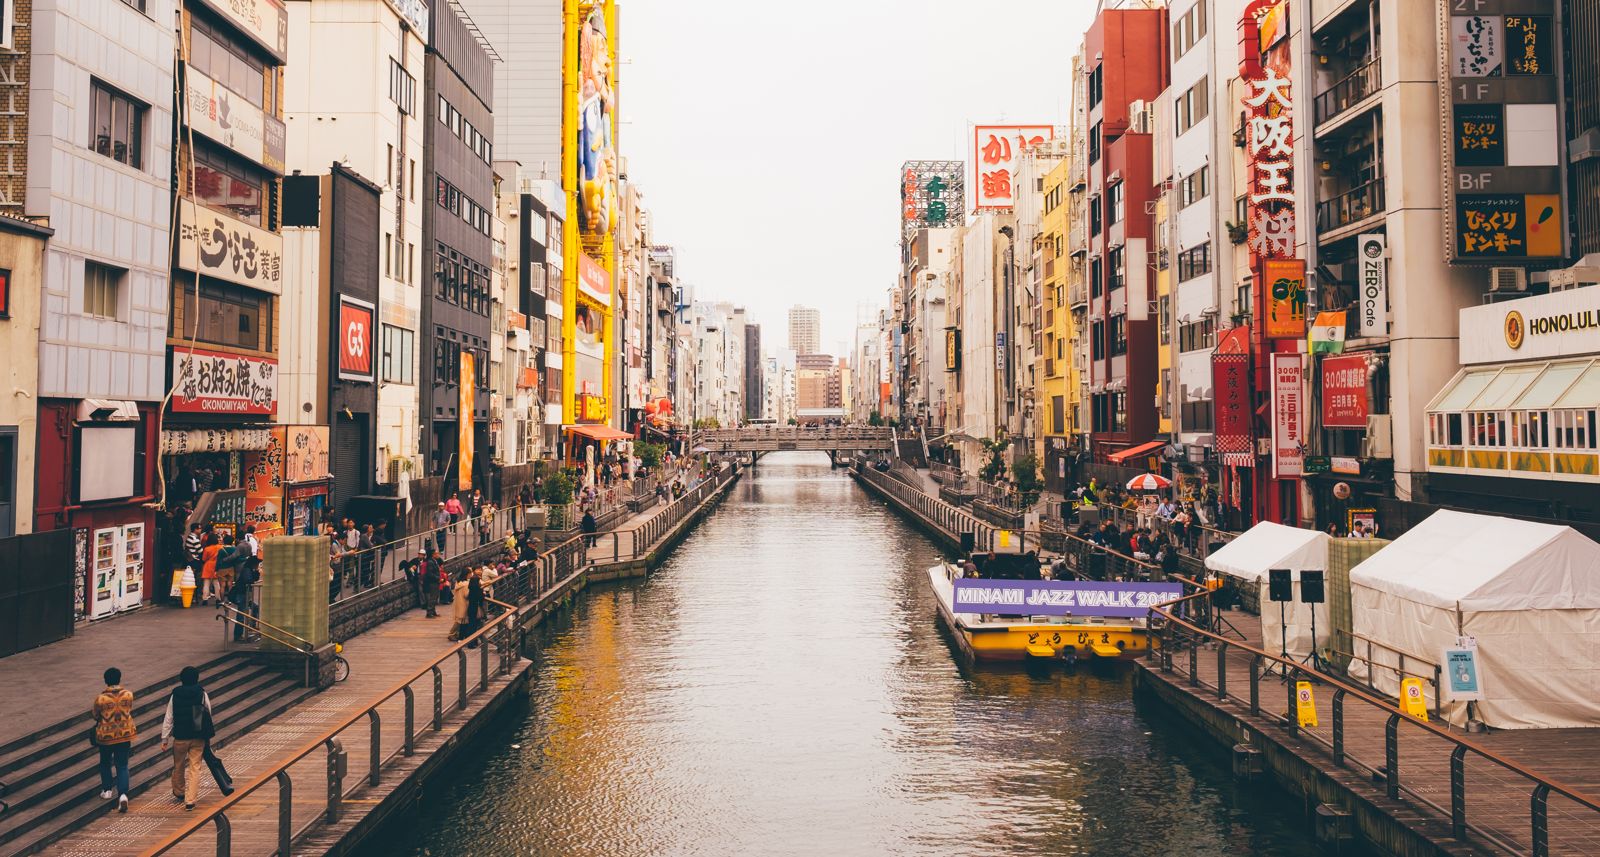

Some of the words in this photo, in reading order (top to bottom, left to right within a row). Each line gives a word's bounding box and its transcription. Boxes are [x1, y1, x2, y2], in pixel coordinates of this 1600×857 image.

[1506, 17, 1521, 28] 2F
[1523, 17, 1539, 74] 山内農場
[1463, 121, 1495, 136] びっくり
[1461, 136, 1498, 150] ドンキー
[1244, 67, 1296, 258] 大阪王将
[1459, 173, 1492, 190] B1F
[1465, 210, 1517, 232] びっくり
[200, 217, 259, 280] うなぎ
[1463, 231, 1522, 252] ドンキー
[1364, 261, 1379, 299] ZERO
[1365, 300, 1380, 327] cafe
[347, 320, 364, 358] G3
[197, 356, 251, 399] お好み焼
[201, 399, 248, 412] OKONOMIYAKI
[957, 587, 1025, 605] MINAMI
[1025, 588, 1075, 607] JAZZ
[1075, 590, 1137, 608] WALK
